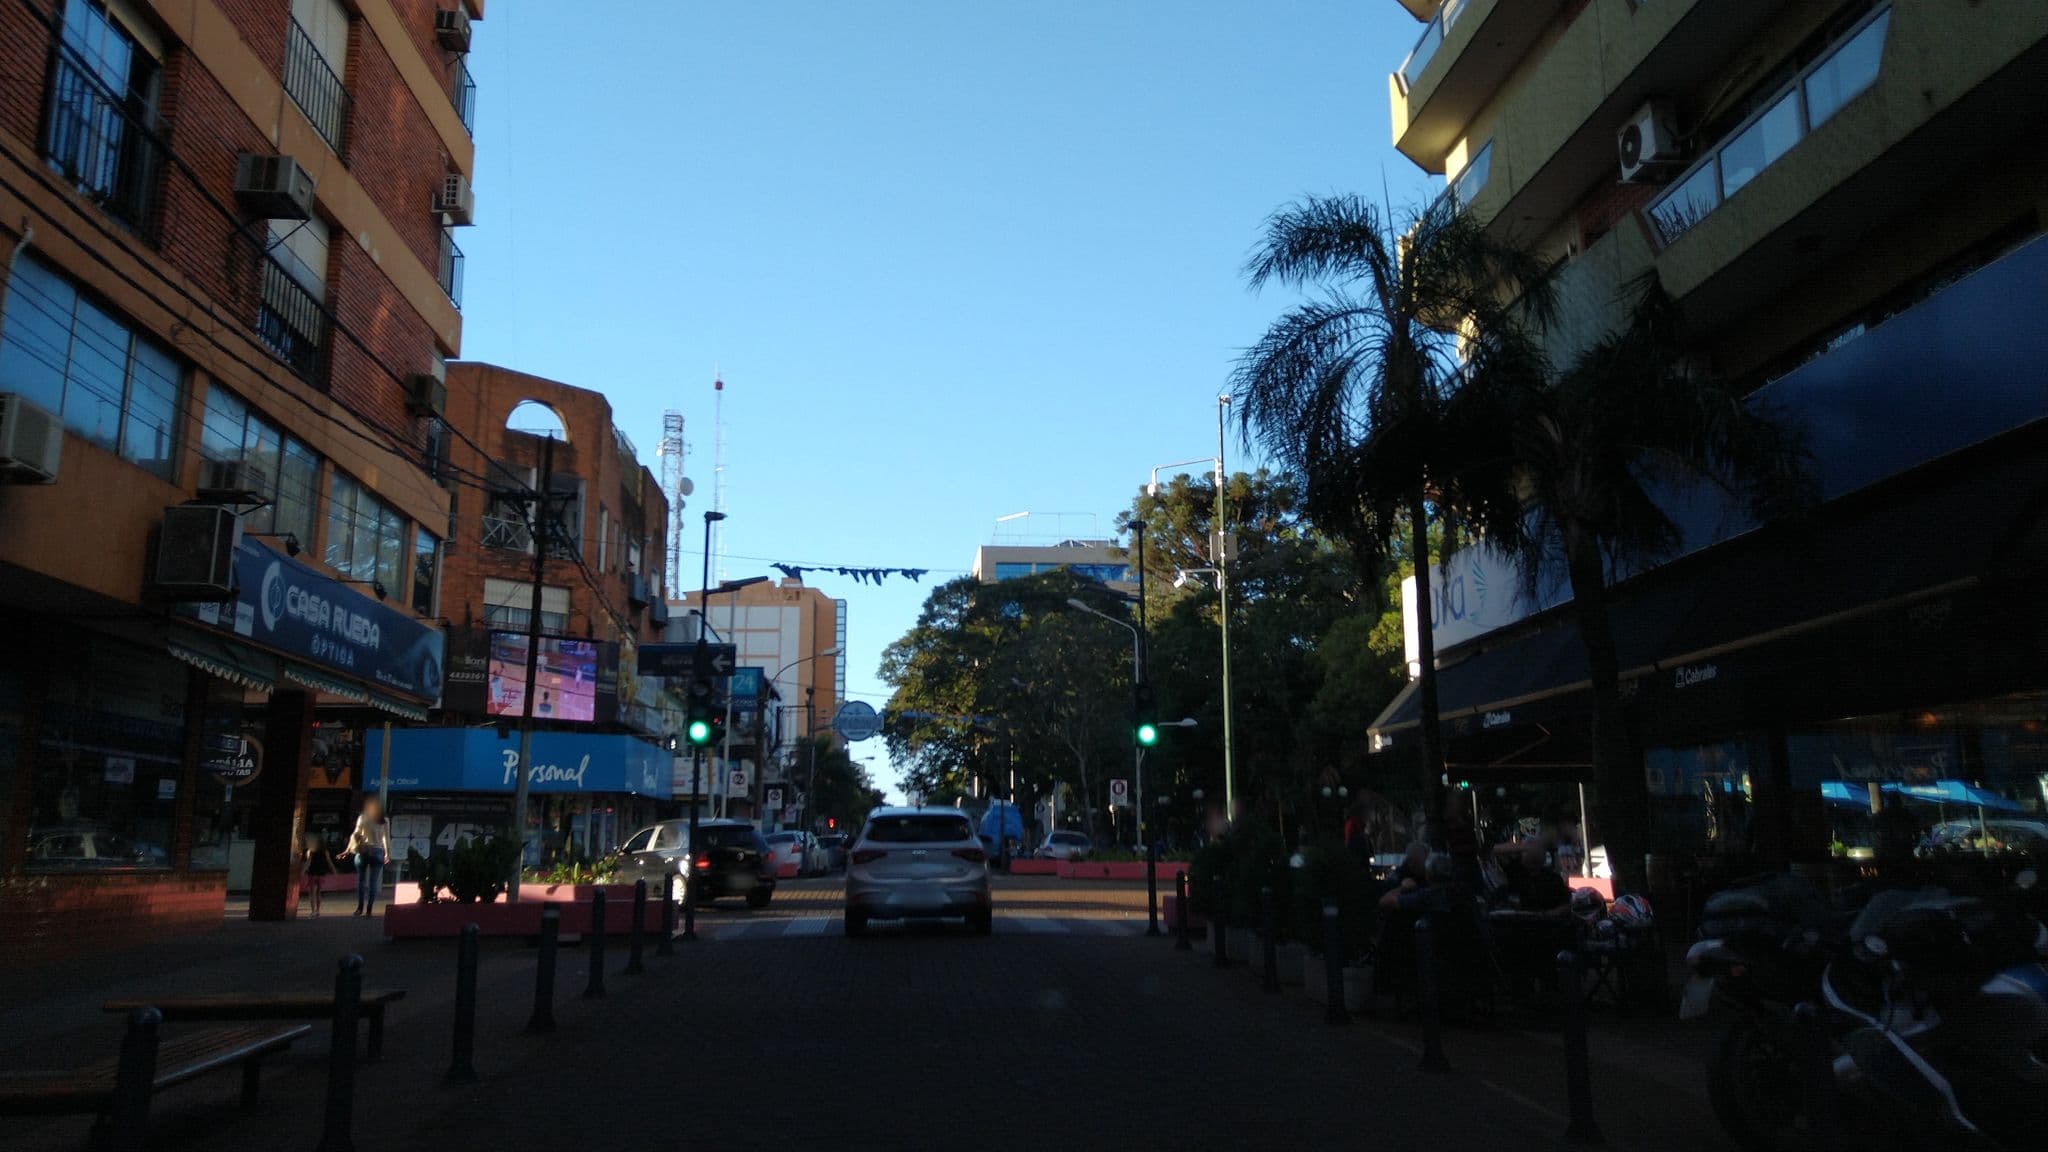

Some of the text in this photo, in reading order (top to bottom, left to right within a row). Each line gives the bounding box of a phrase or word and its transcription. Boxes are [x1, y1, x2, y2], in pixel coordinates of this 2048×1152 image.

[286, 584, 381, 650] CASA RUEDA
[502, 750, 591, 788] Prsonal
